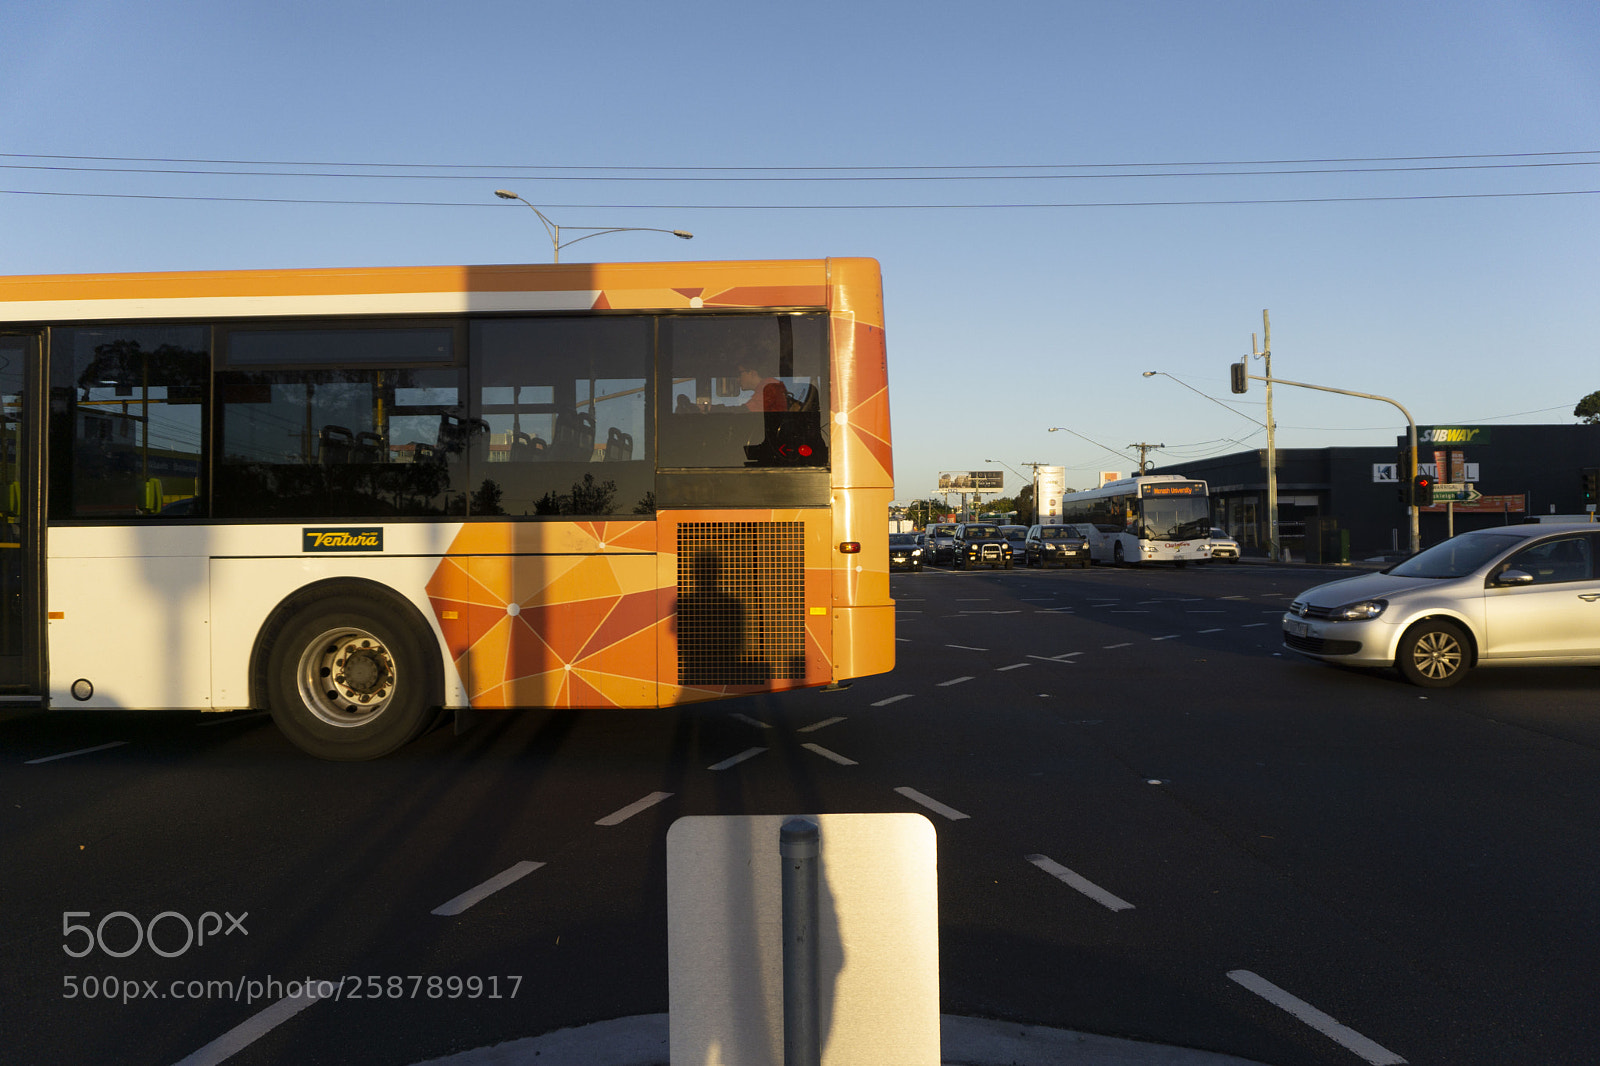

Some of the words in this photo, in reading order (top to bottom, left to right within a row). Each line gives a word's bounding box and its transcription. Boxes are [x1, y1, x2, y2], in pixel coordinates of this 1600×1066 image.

[1420, 428, 1479, 442] SUBWAY
[1171, 486, 1192, 495] University
[306, 532, 379, 547] Ventura
